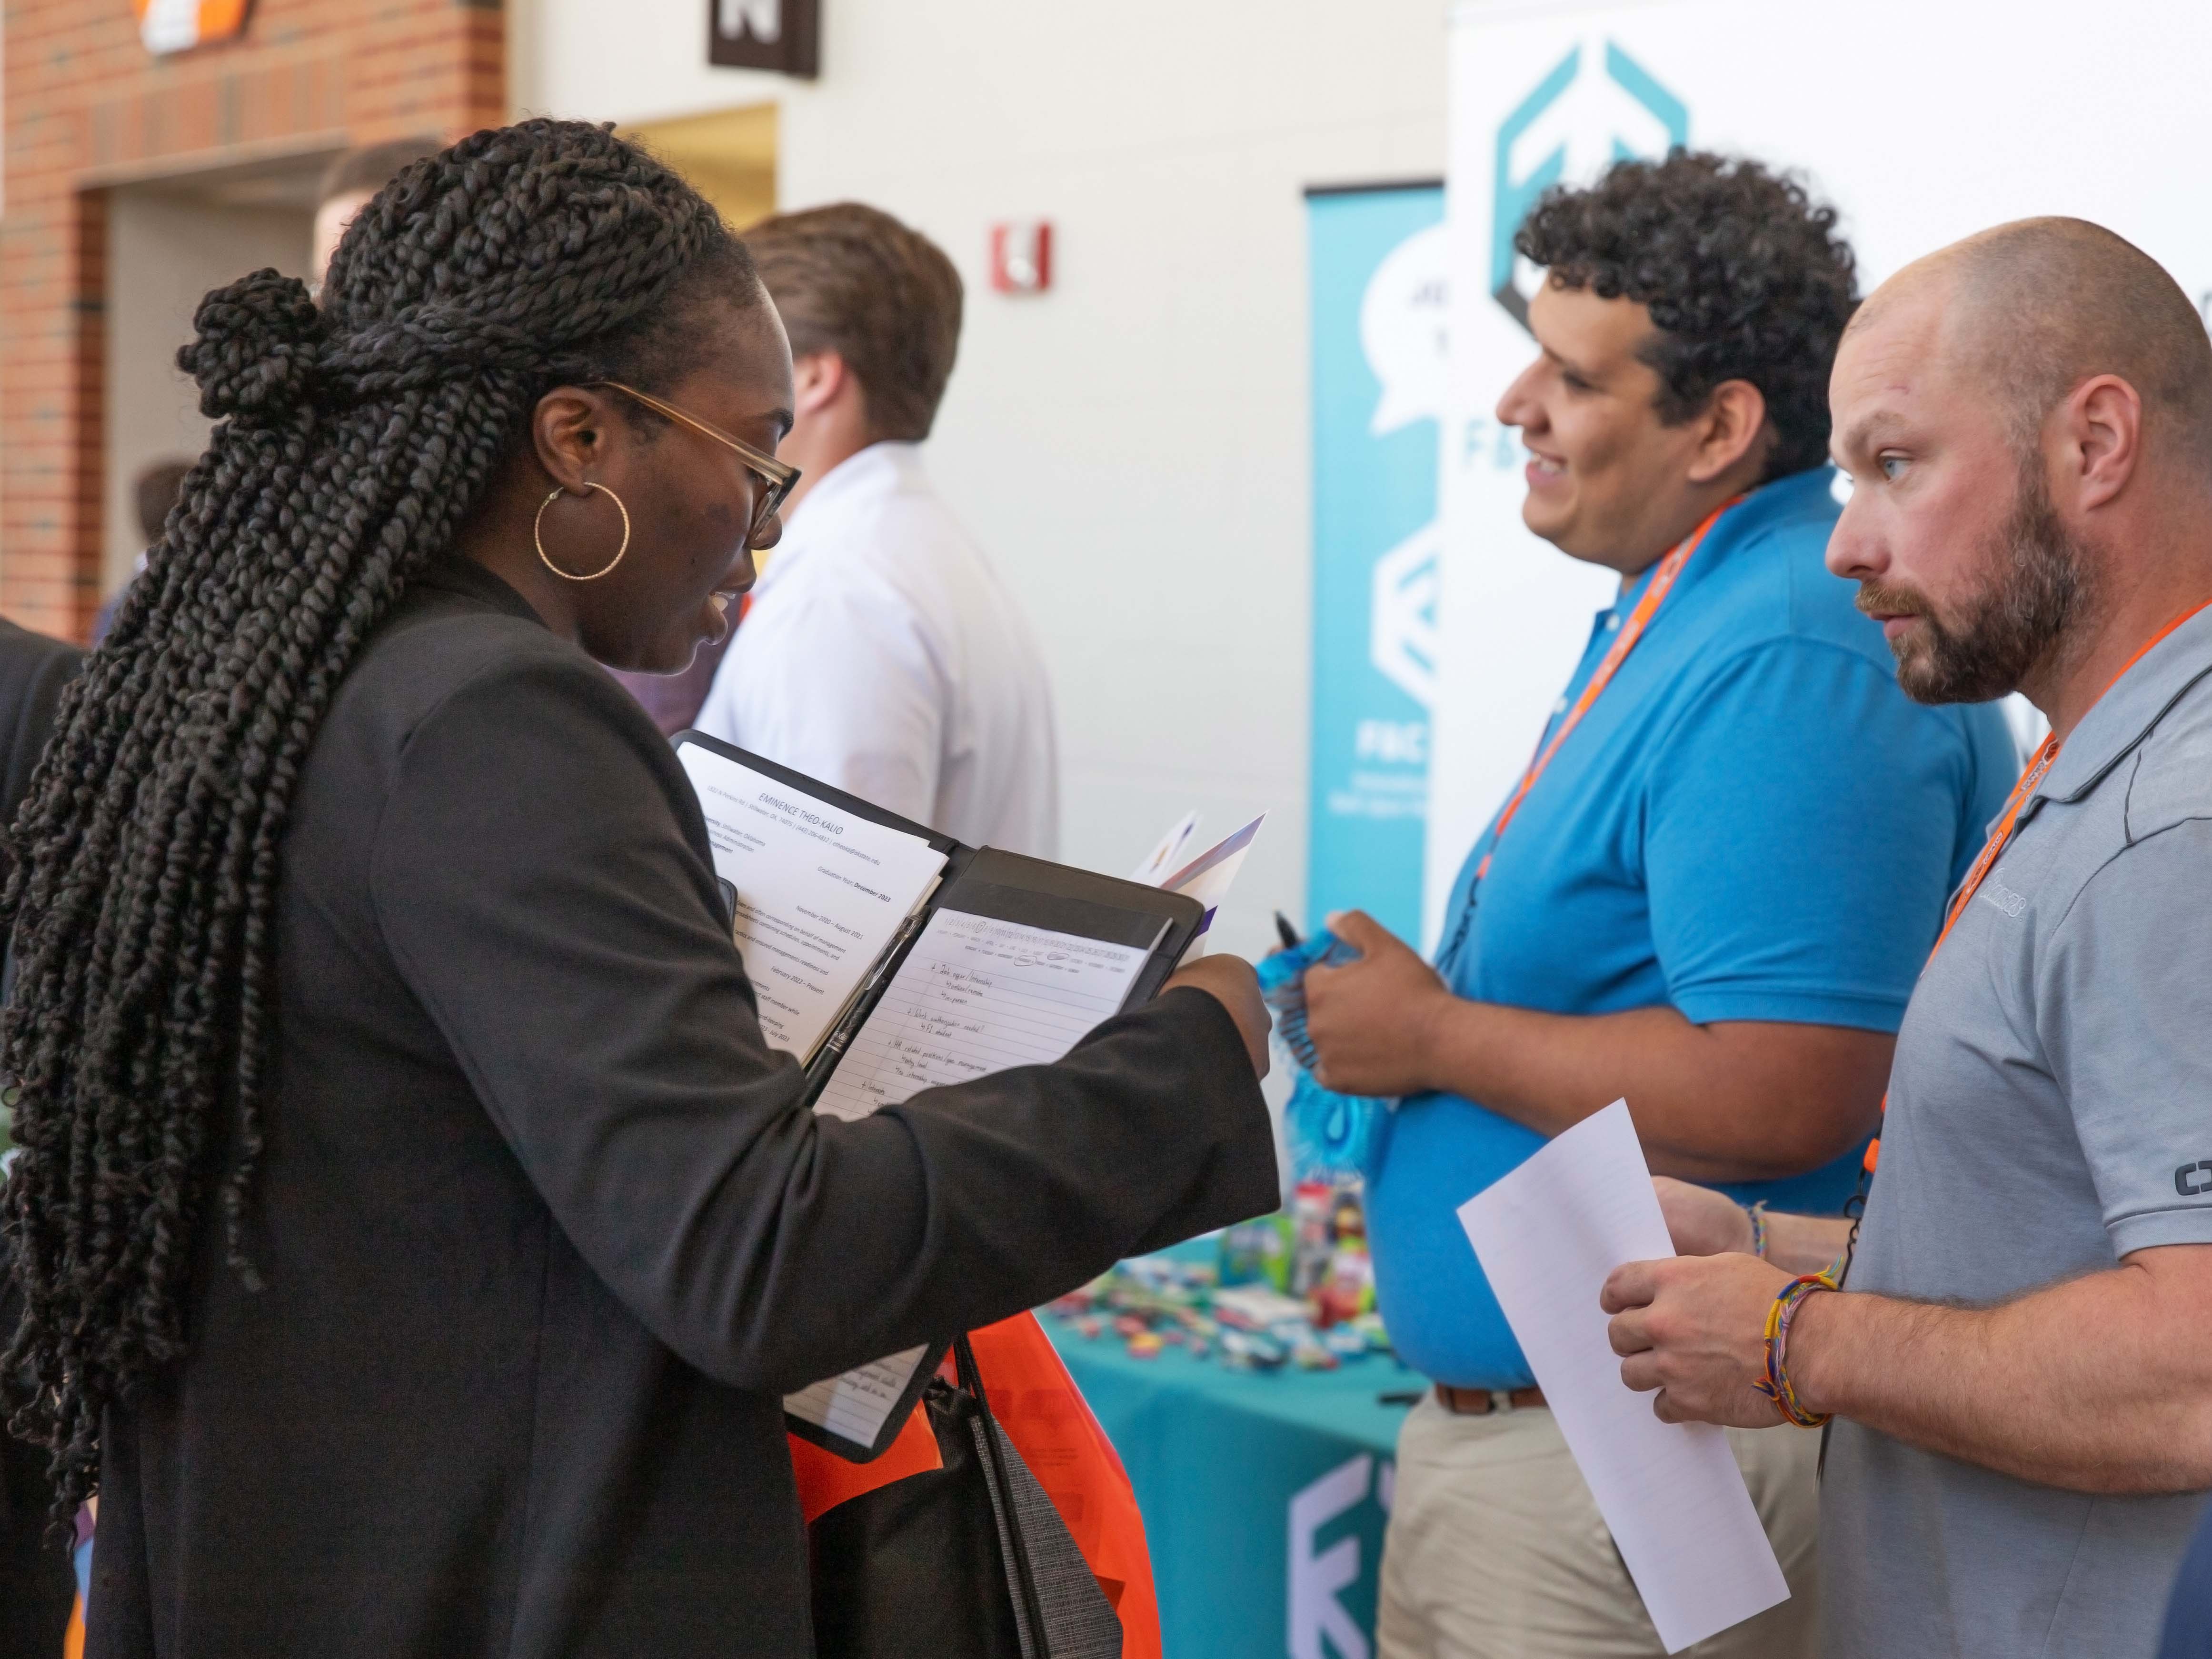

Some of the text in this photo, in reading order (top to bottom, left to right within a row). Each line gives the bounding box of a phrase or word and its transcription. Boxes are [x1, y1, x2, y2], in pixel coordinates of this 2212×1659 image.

[758, 793, 844, 835] EMINENCE THEO-KALIO
[817, 866, 841, 880] Graduation
[854, 882, 878, 897] December
[878, 894, 891, 903] 2023
[766, 914, 794, 930] corresponding
[800, 929, 815, 938] behalf
[818, 938, 846, 953] management
[796, 905, 864, 940] November 2020 August 2021
[770, 966, 825, 995] February 2022 Present
[799, 960, 819, 971] readiness
[770, 999, 788, 1010] member
[778, 1033, 790, 1042] 2023
